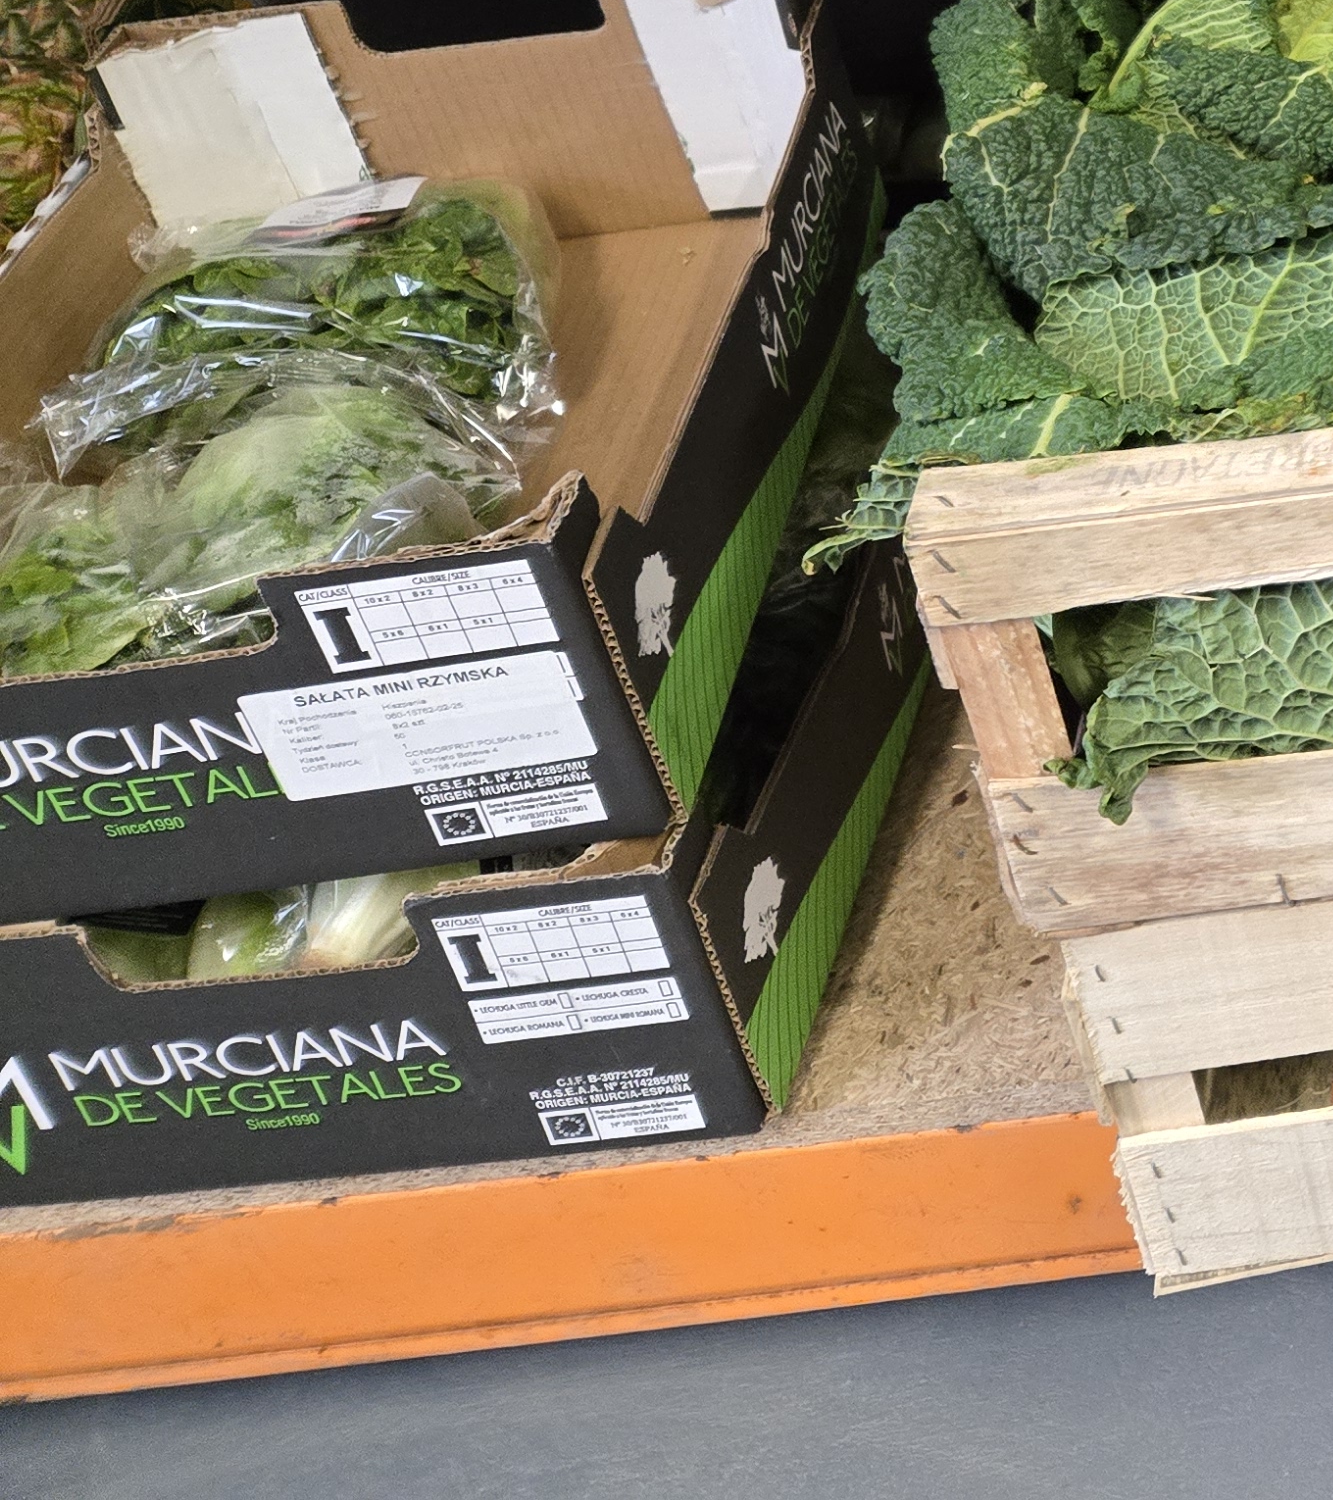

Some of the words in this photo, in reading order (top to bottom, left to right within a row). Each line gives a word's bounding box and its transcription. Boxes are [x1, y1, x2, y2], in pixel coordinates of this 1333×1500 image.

[772, 101, 847, 312] MURCIANA
[294, 687, 370, 707] SAŁATA
[373, 680, 414, 696] MINI
[419, 666, 509, 688] RZYMSKA
[420, 790, 479, 806] ORIGEN:
[49, 1019, 448, 1092] MURCIANA
[73, 1091, 157, 1128] DE
[155, 1063, 462, 1119] VEGETALES
[534, 1094, 590, 1110] ORIGEN:
